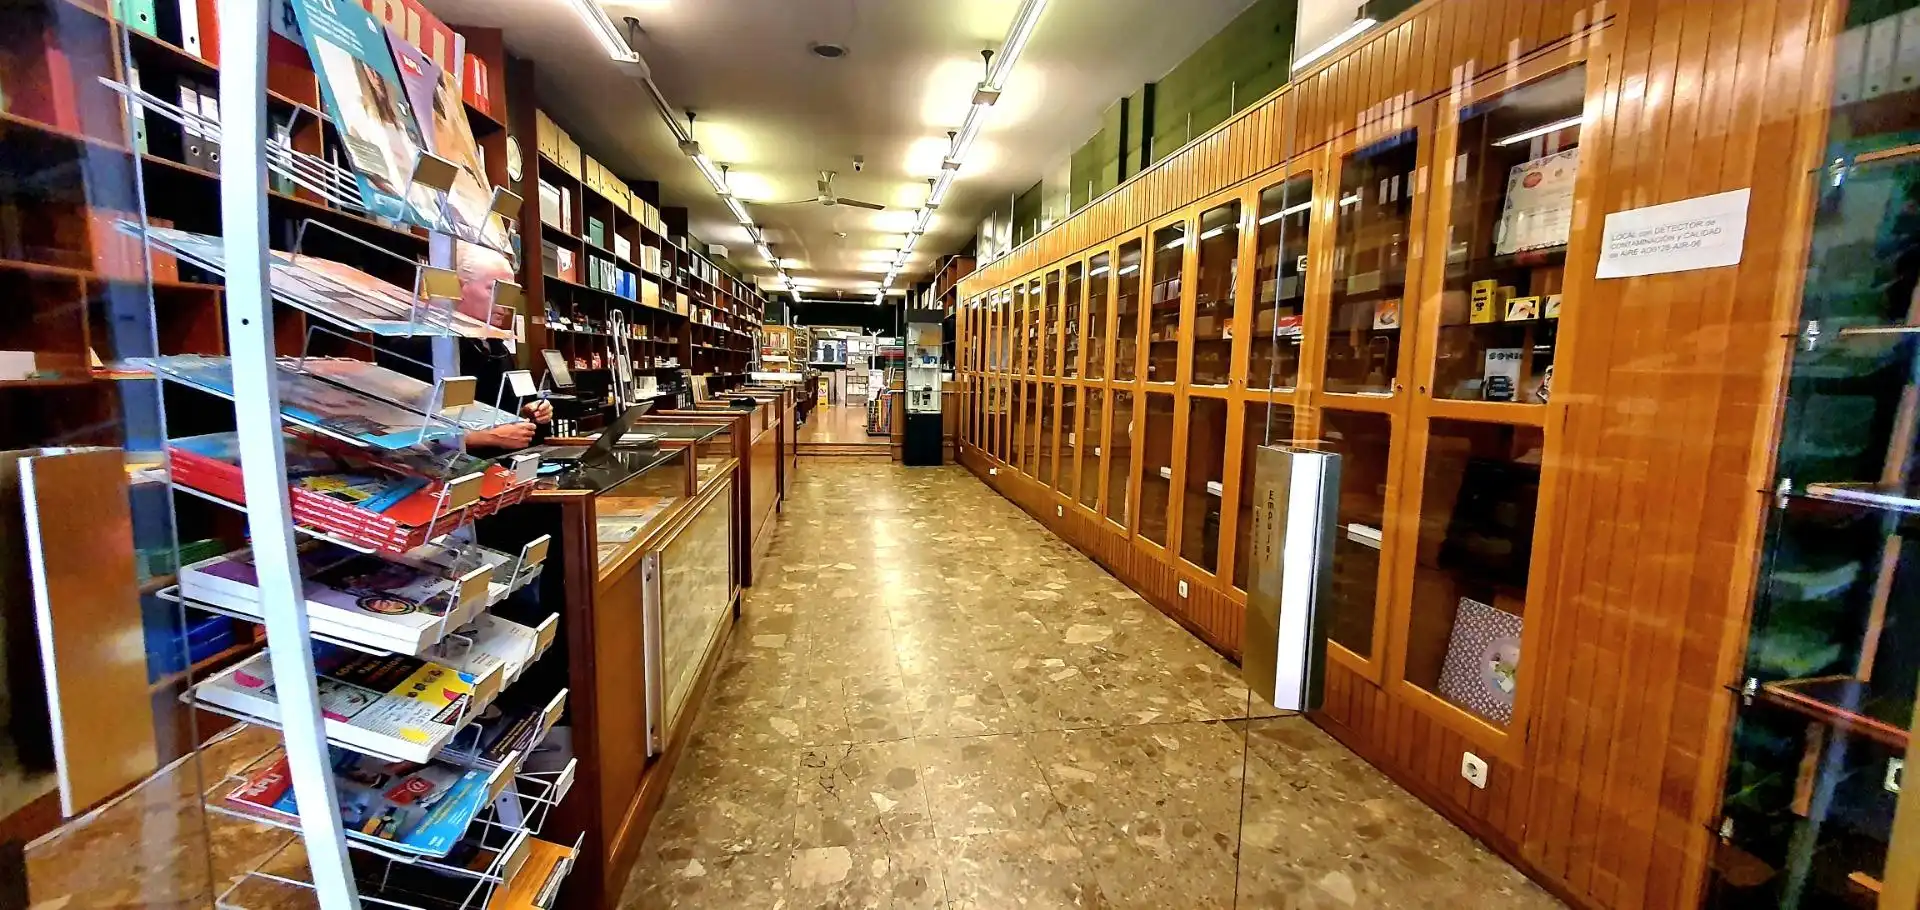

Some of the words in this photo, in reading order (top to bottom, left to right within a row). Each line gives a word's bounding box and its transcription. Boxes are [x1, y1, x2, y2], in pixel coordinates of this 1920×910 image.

[1611, 231, 1636, 242] LOCAL
[1654, 220, 1704, 235] DETECTOR
[1684, 227, 1722, 239] CALIDAD
